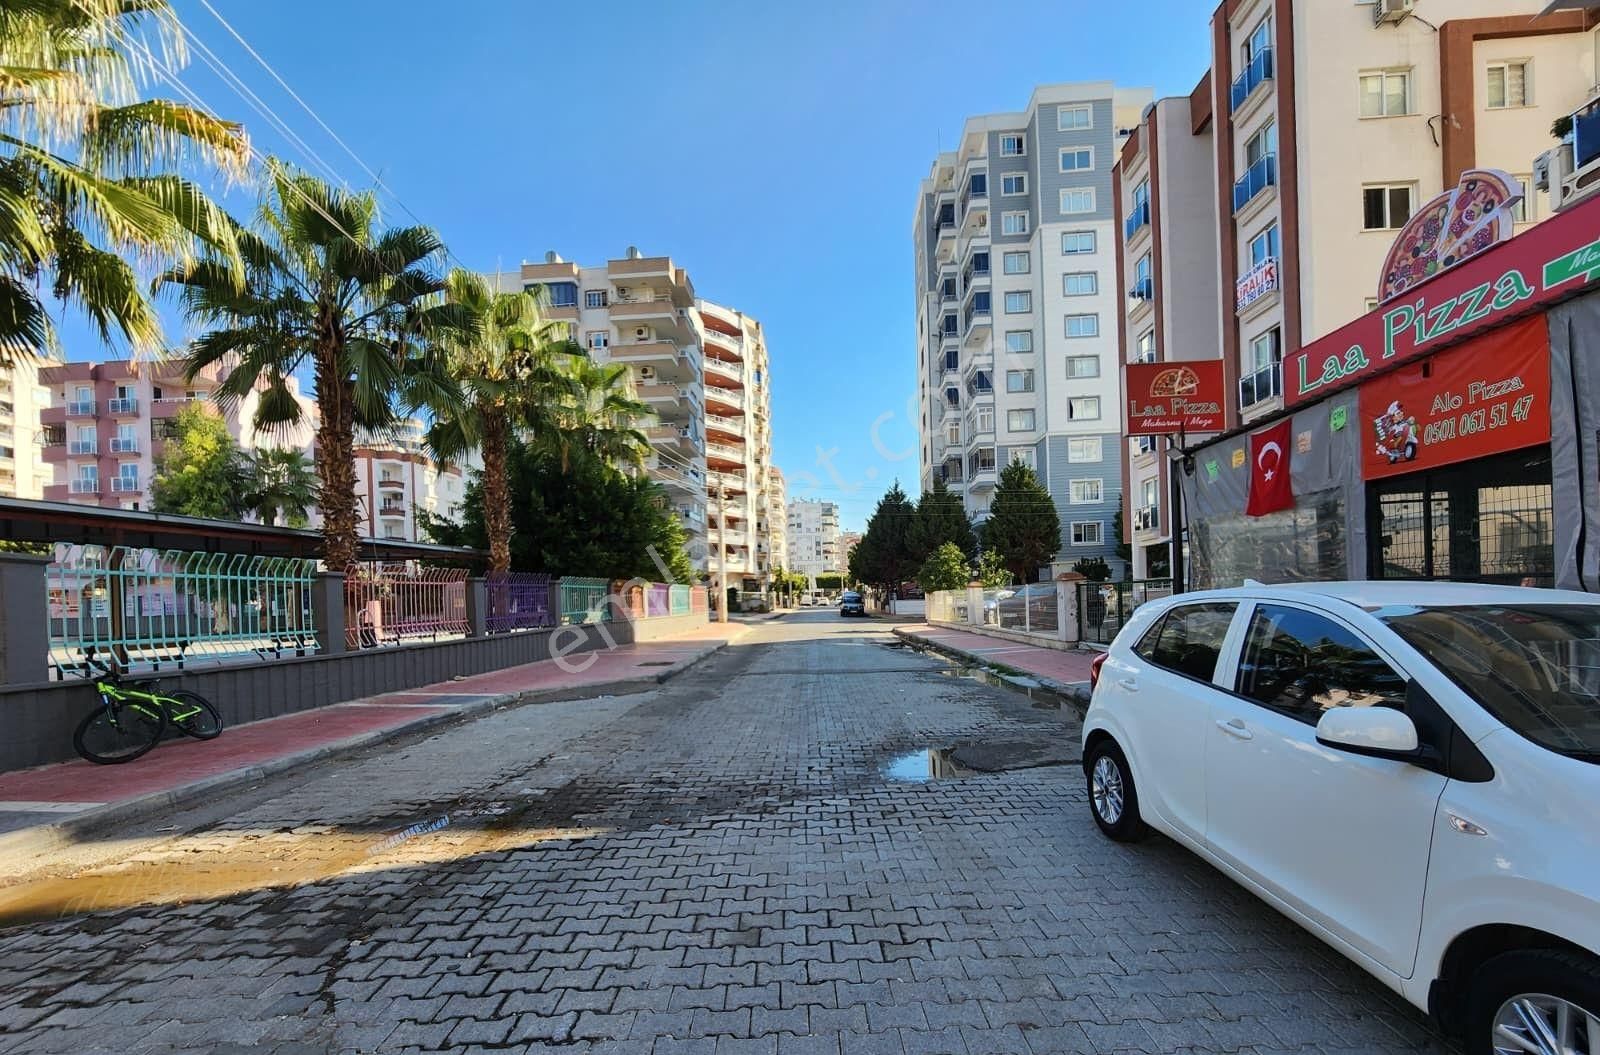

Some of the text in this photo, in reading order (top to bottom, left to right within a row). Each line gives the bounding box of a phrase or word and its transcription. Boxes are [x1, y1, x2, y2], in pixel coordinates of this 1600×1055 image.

[1298, 269, 1534, 395] Laa Pizza
[1131, 398, 1221, 417] Laa Pizza
[1430, 376, 1525, 416] Alo Pizza
[1423, 394, 1534, 446] 0501 061 51 47
